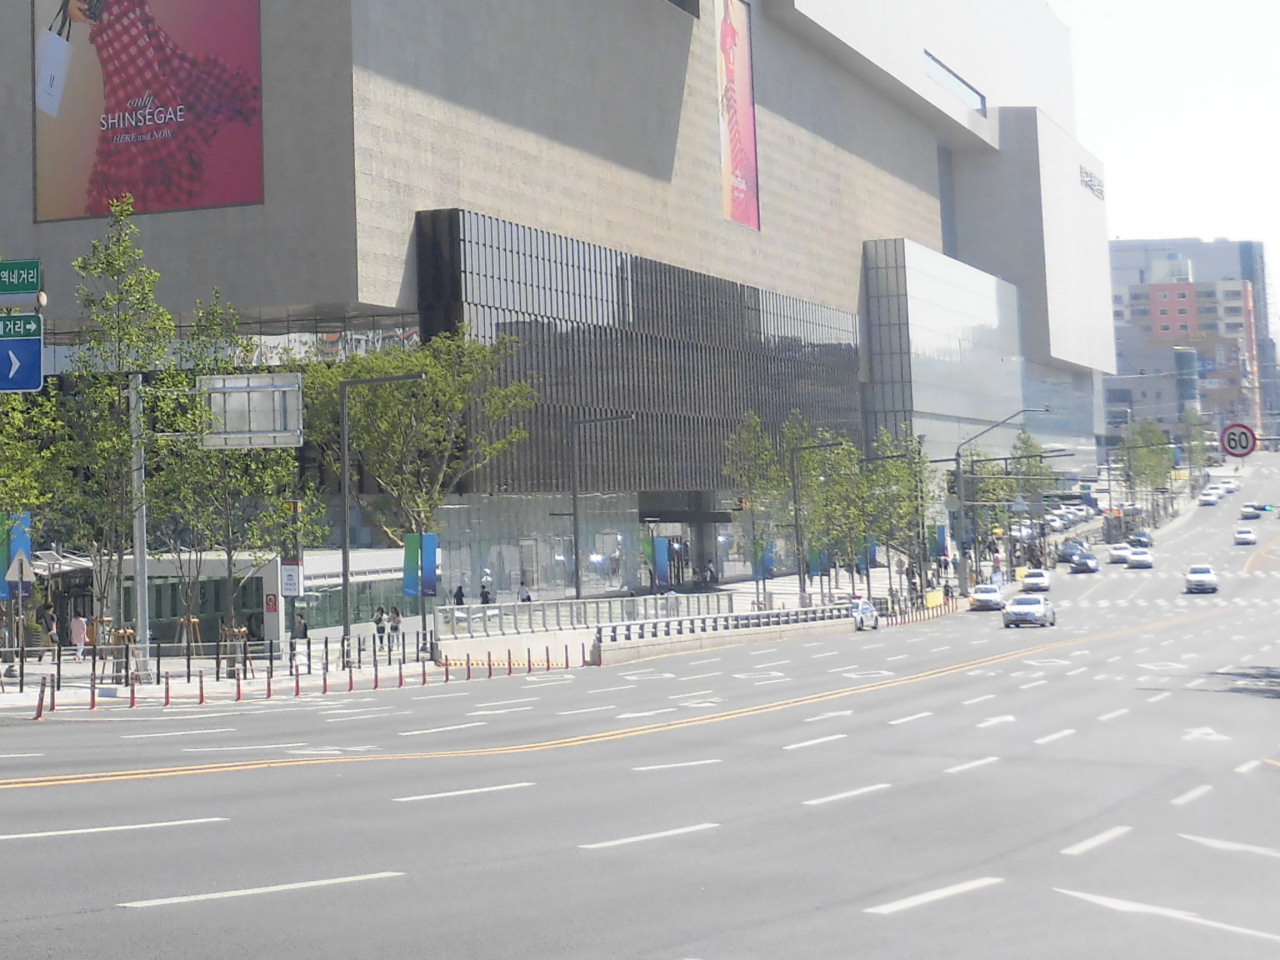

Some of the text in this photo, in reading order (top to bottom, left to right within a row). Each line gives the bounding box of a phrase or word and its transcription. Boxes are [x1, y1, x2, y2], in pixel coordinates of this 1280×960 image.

[127, 89, 154, 115] only
[100, 105, 185, 131] SHINSEGAE
[1227, 431, 1249, 449] 60
